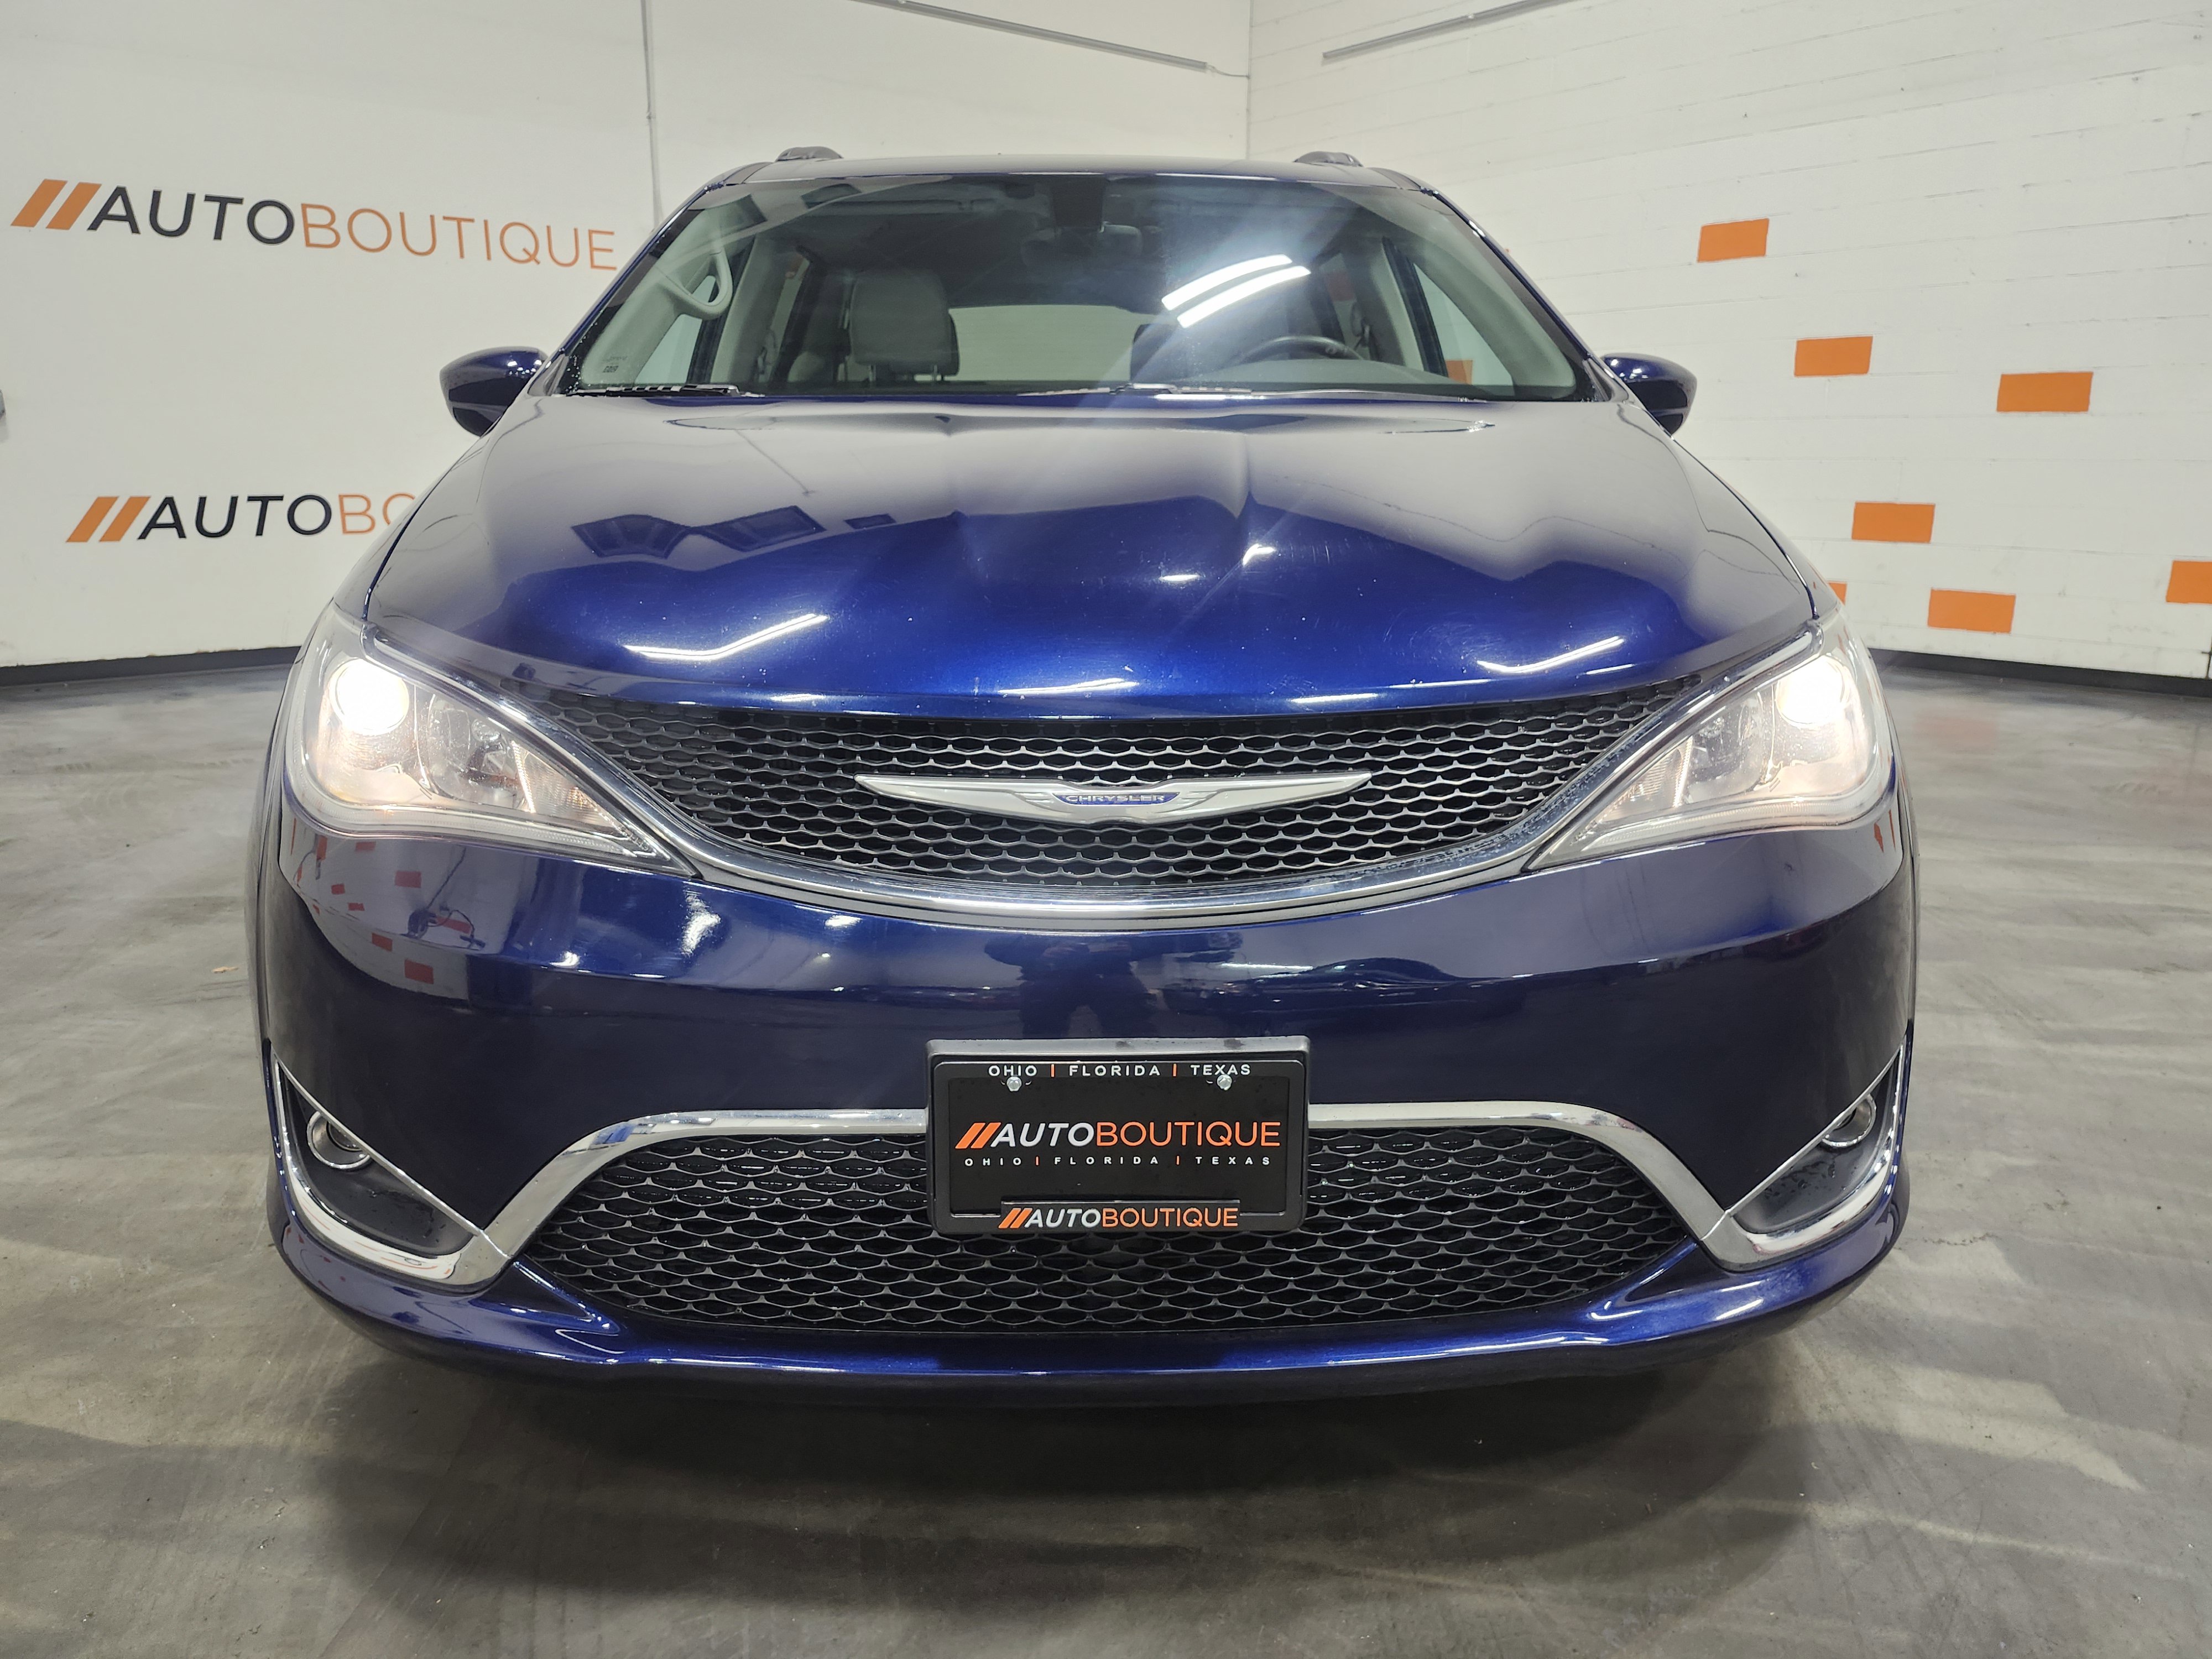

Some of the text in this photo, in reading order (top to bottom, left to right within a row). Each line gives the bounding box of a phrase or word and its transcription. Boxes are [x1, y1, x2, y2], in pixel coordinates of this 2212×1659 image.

[87, 186, 617, 271] AUTOBOUTIQUE
[988, 1064, 1250, 1077] OHIO FLORIDA TEXAS
[990, 1121, 1281, 1147] AUTOBOUTIQUE
[964, 1156, 1270, 1166] OHIO FLORIDA TEXAS
[1024, 1207, 1238, 1228] AUTOBOUTIQUE
